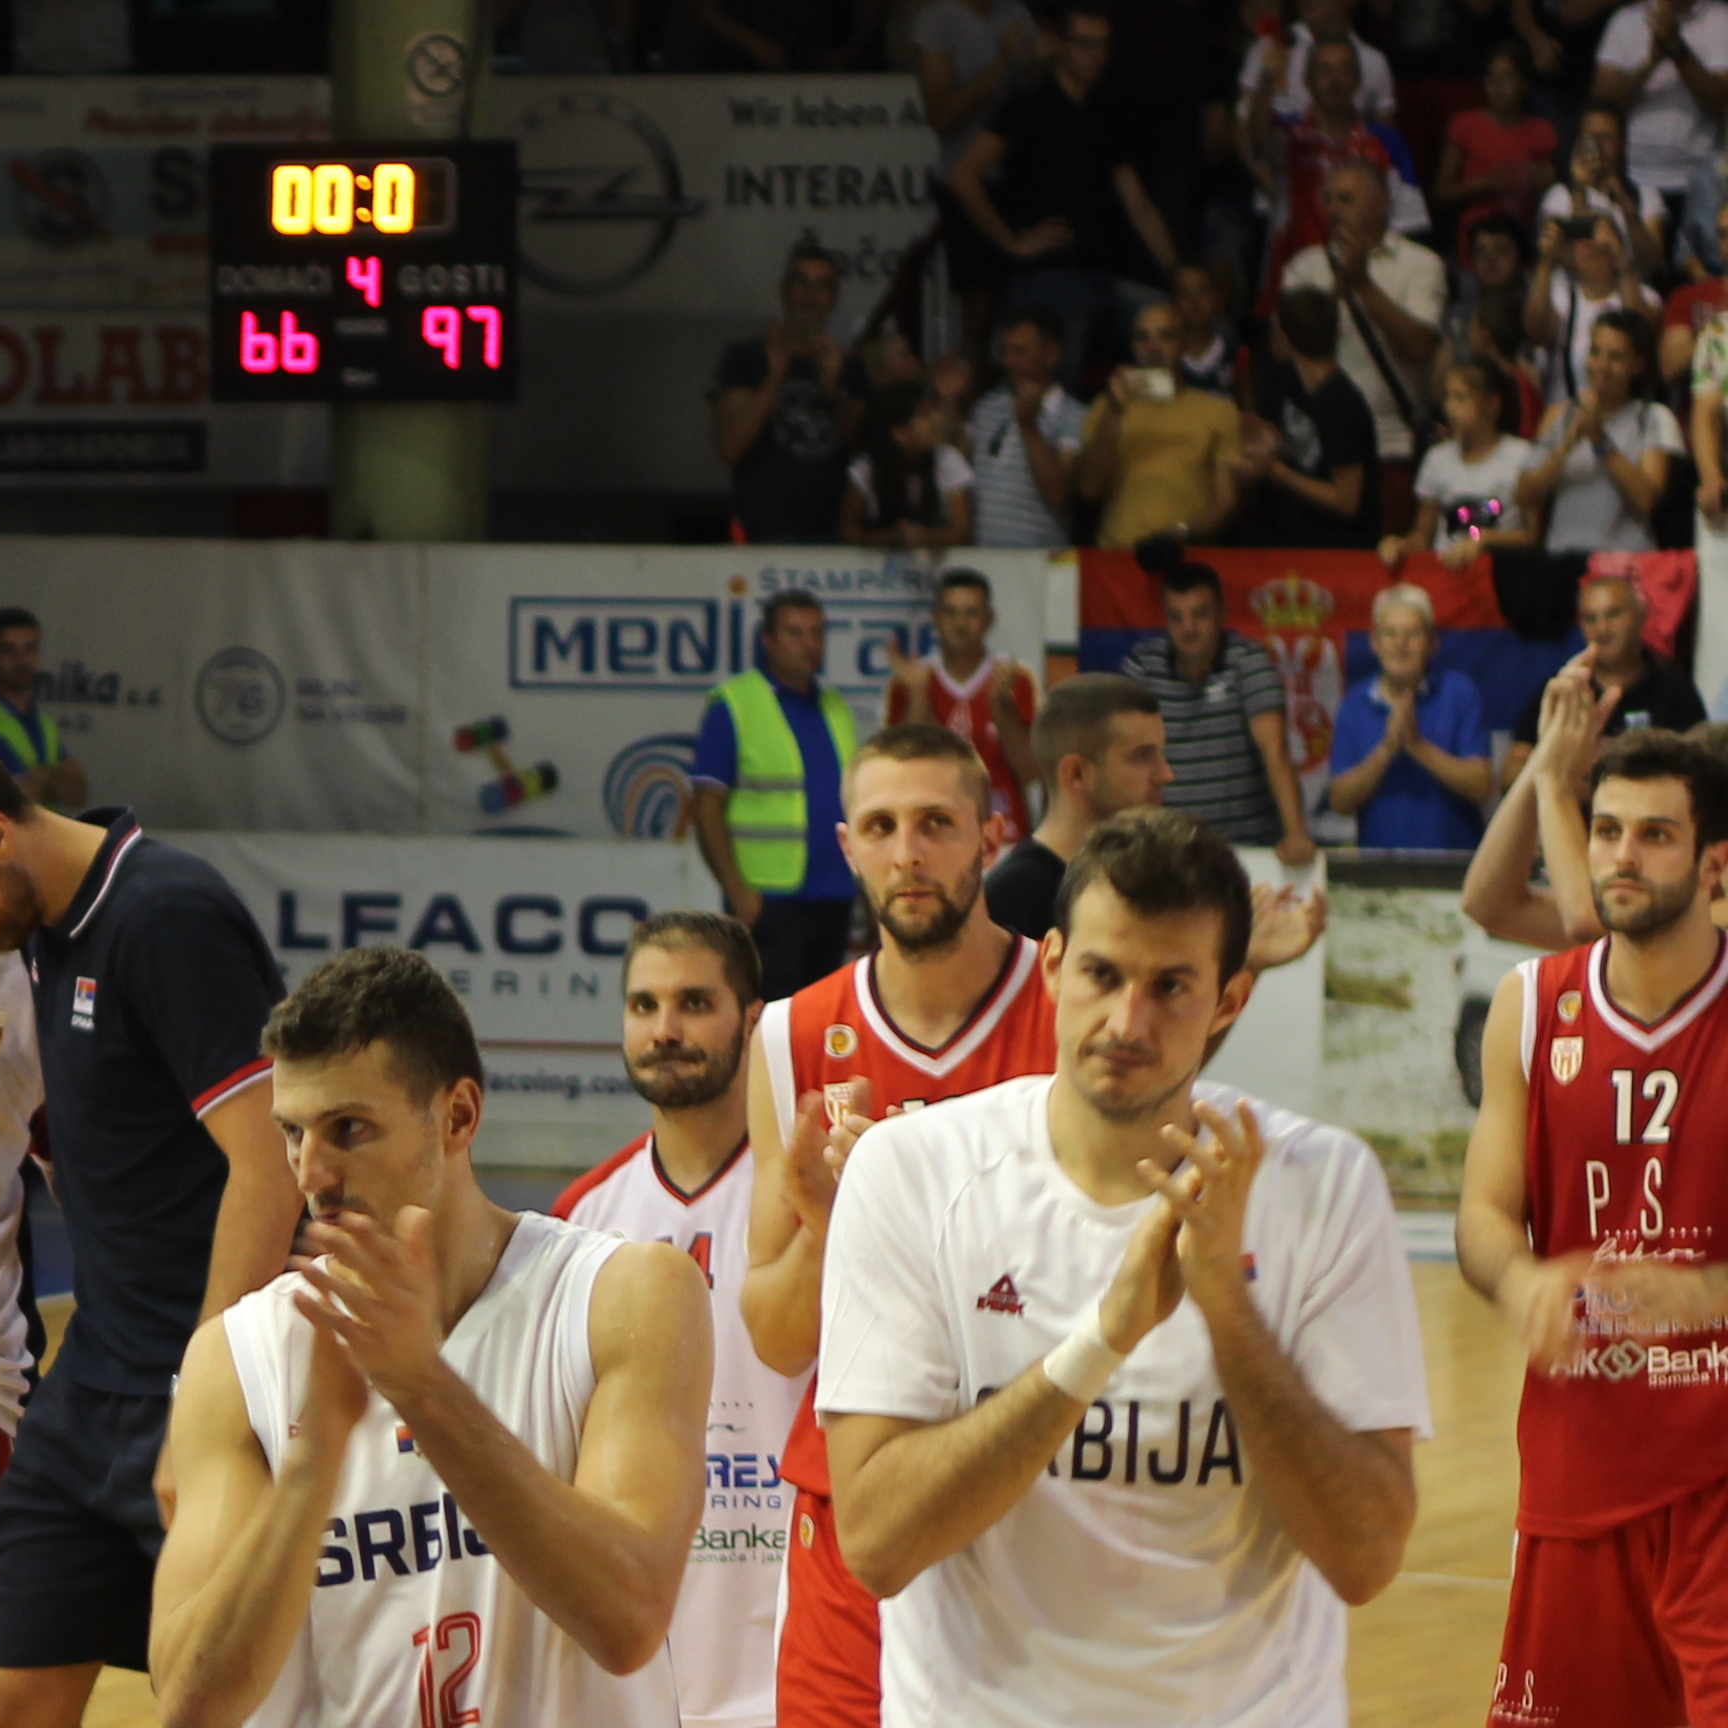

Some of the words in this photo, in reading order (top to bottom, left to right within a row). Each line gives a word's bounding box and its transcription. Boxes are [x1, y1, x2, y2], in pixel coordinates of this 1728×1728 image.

[271, 162, 417, 236] 00:0
[726, 164, 937, 207] INTERAU
[345, 255, 383, 309] 4
[398, 262, 506, 297] GOSTI
[421, 304, 503, 370] 97
[278, 892, 652, 957] LFACO
[1610, 1068, 1680, 1144] 12
[1647, 1340, 1728, 1376] Bank
[1044, 1396, 1244, 1487] BIJA
[314, 1492, 496, 1588] SRBIJ
